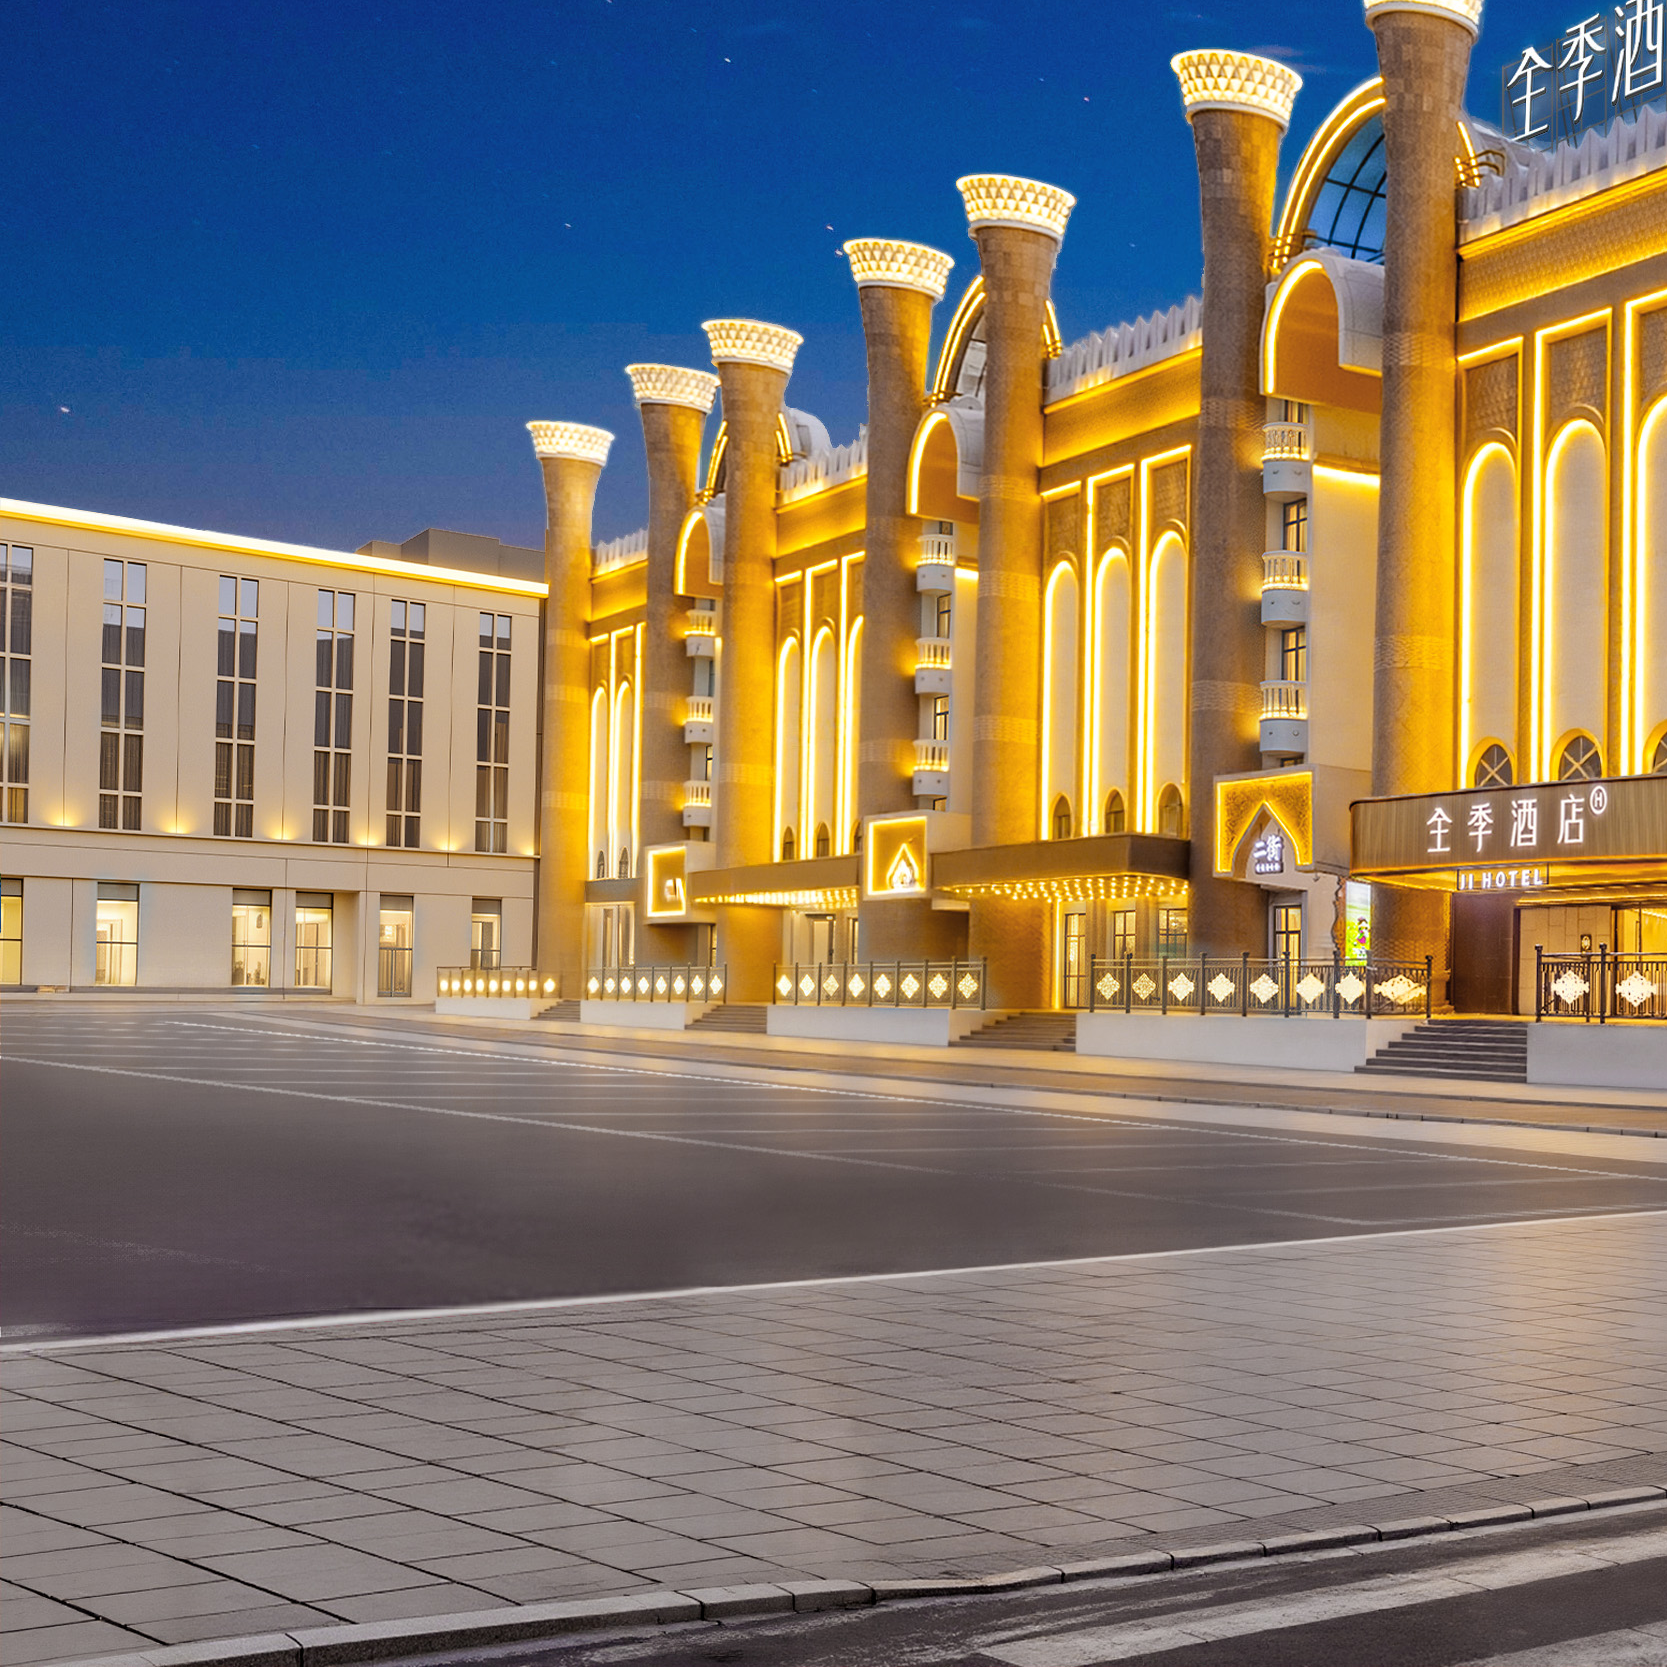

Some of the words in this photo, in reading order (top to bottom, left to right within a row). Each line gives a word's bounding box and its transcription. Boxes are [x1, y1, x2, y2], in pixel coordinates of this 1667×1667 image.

[1426, 793, 1585, 853] 全季酒店
[1482, 868, 1543, 889] HOTEL
